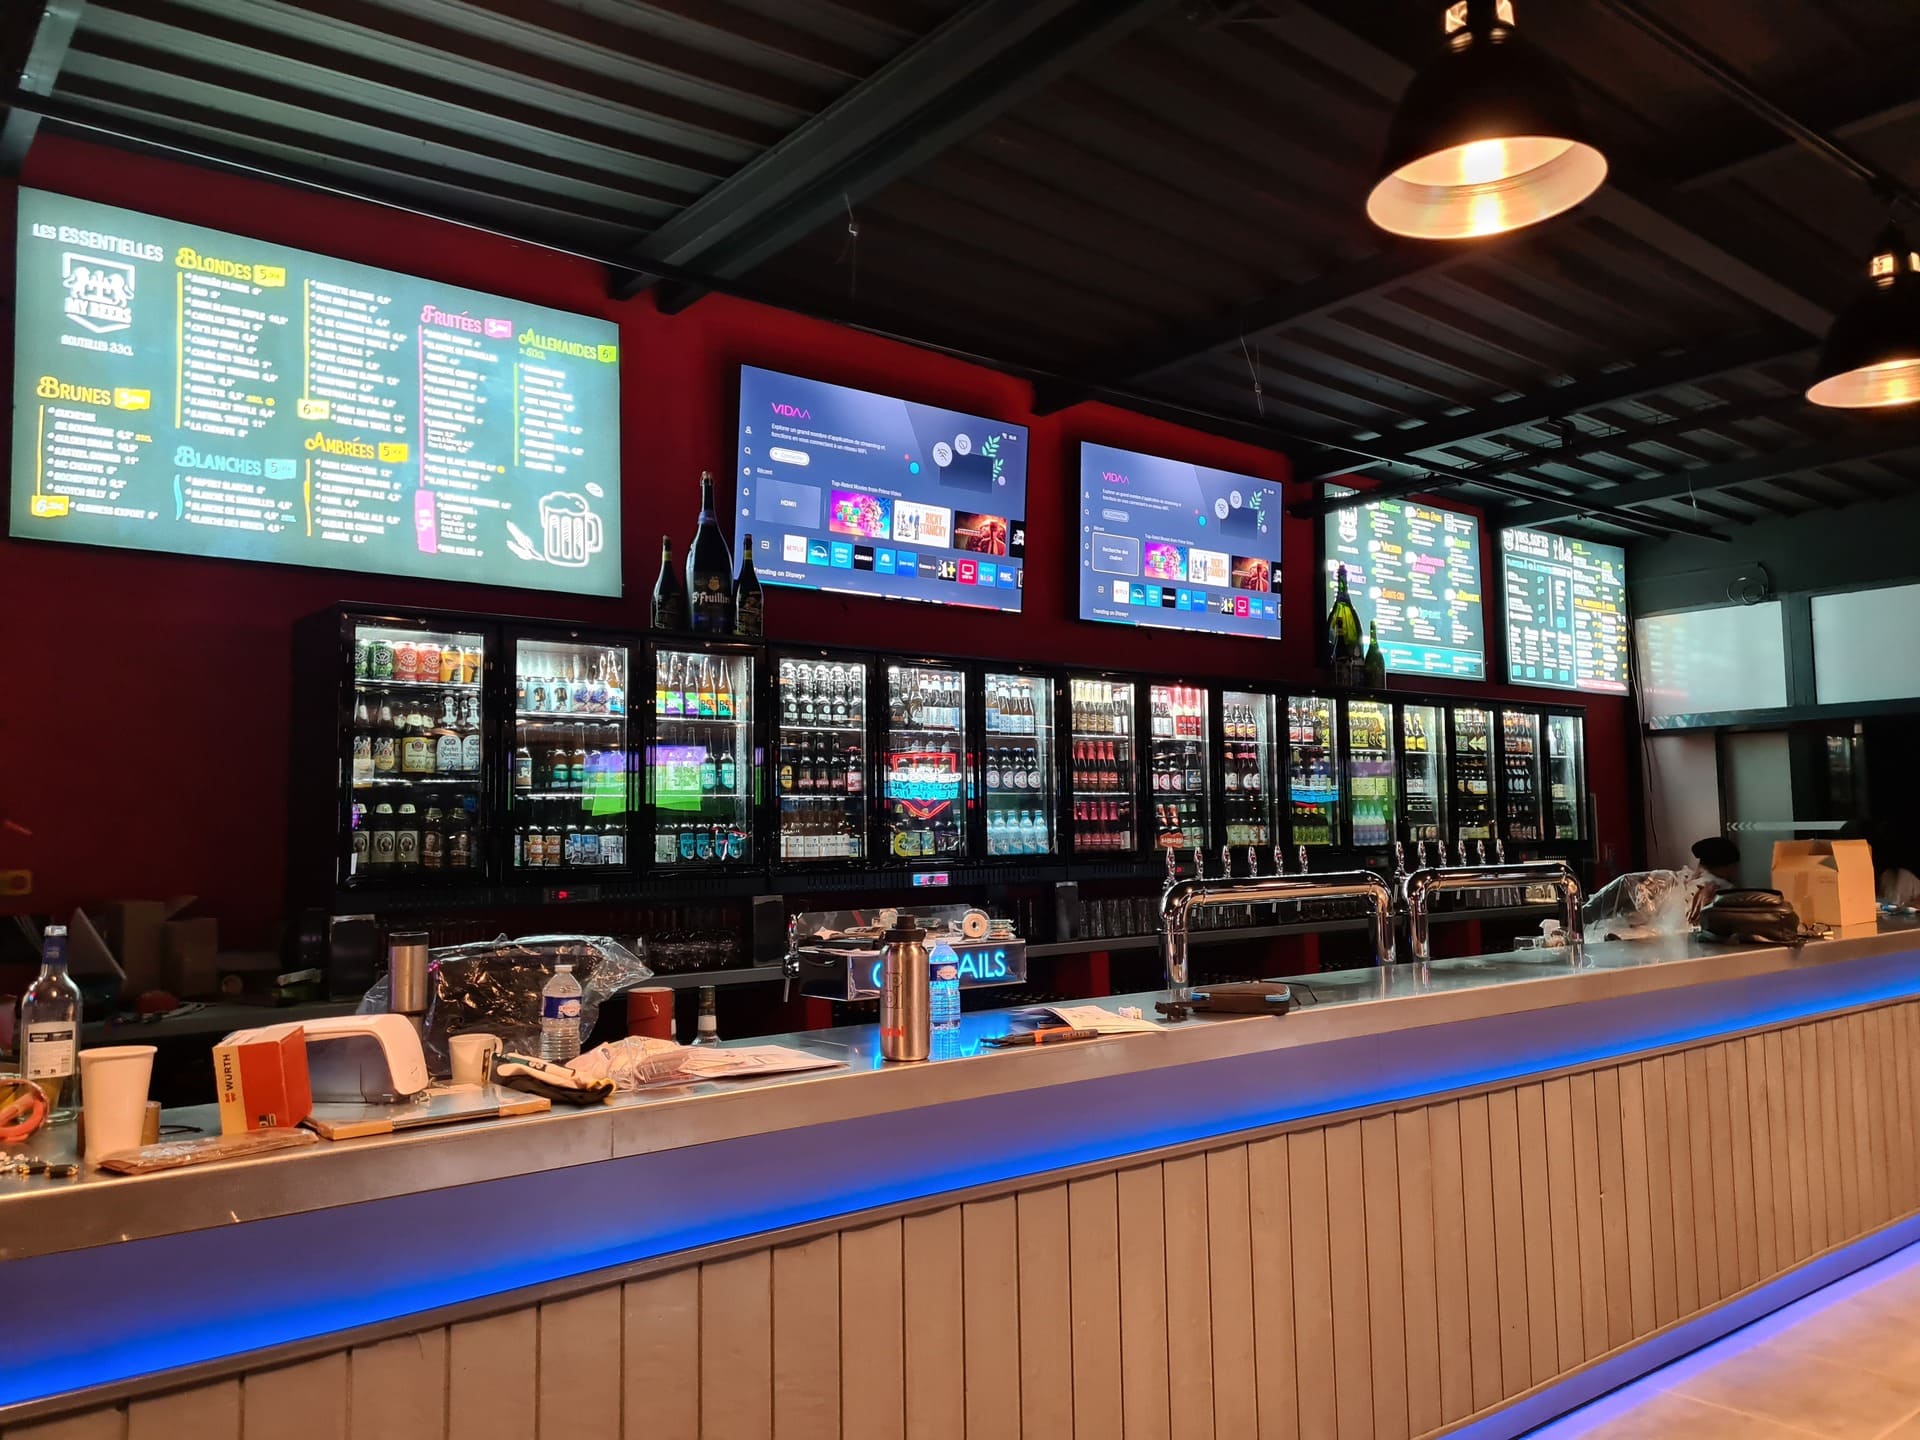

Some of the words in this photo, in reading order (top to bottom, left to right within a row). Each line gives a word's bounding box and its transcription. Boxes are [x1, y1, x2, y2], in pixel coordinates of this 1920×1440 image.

[32, 223, 57, 239] LES
[58, 226, 164, 262] ESSENTIELLES
[175, 248, 253, 281] BLONDES
[64, 297, 89, 315] MY
[421, 305, 482, 333] FRUITÉES
[518, 328, 597, 360] ALLEMANDES
[37, 376, 111, 405] BRUNES
[304, 432, 375, 459] AMBRÉES
[174, 446, 262, 476] BLANCHES
